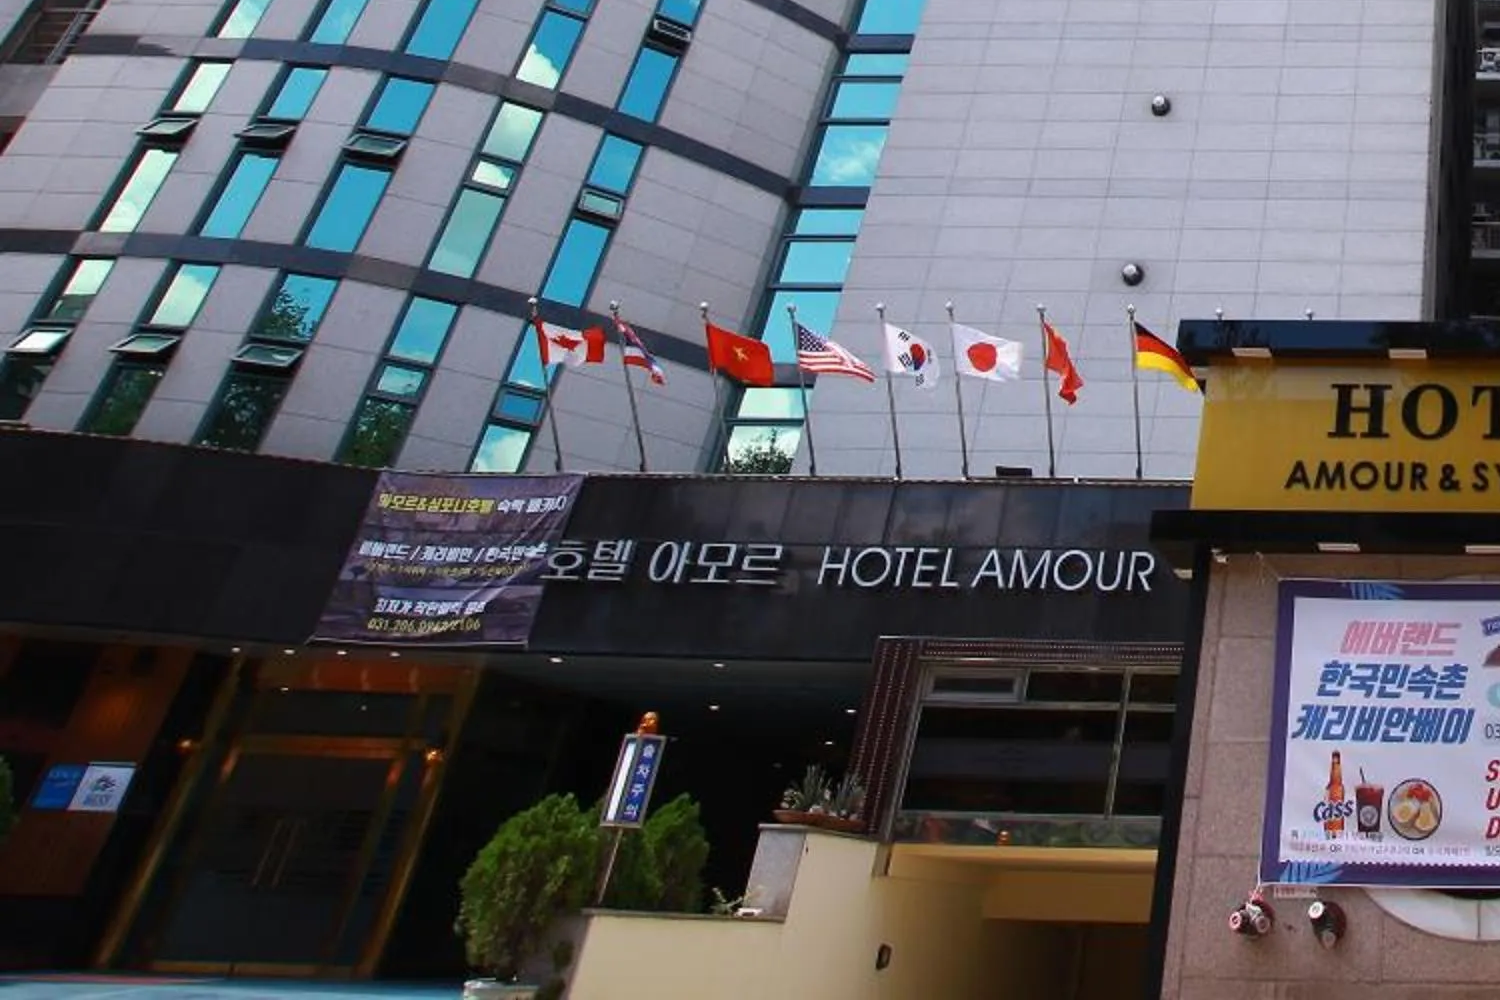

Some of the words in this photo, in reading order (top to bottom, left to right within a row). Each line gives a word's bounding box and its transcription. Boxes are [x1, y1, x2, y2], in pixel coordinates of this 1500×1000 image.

[1285, 460, 1428, 492] AMOUR
[1438, 462, 1461, 491] &
[539, 539, 633, 581] 호텔
[649, 541, 783, 584] 아모르
[817, 546, 960, 587] HOTEL
[970, 548, 1156, 591] AMOUR
[1340, 620, 1463, 657] 에버랜드
[1317, 660, 1469, 700] 한국민속촌
[1291, 704, 1476, 744] 캐리비안베이
[1313, 800, 1354, 823] Cass
